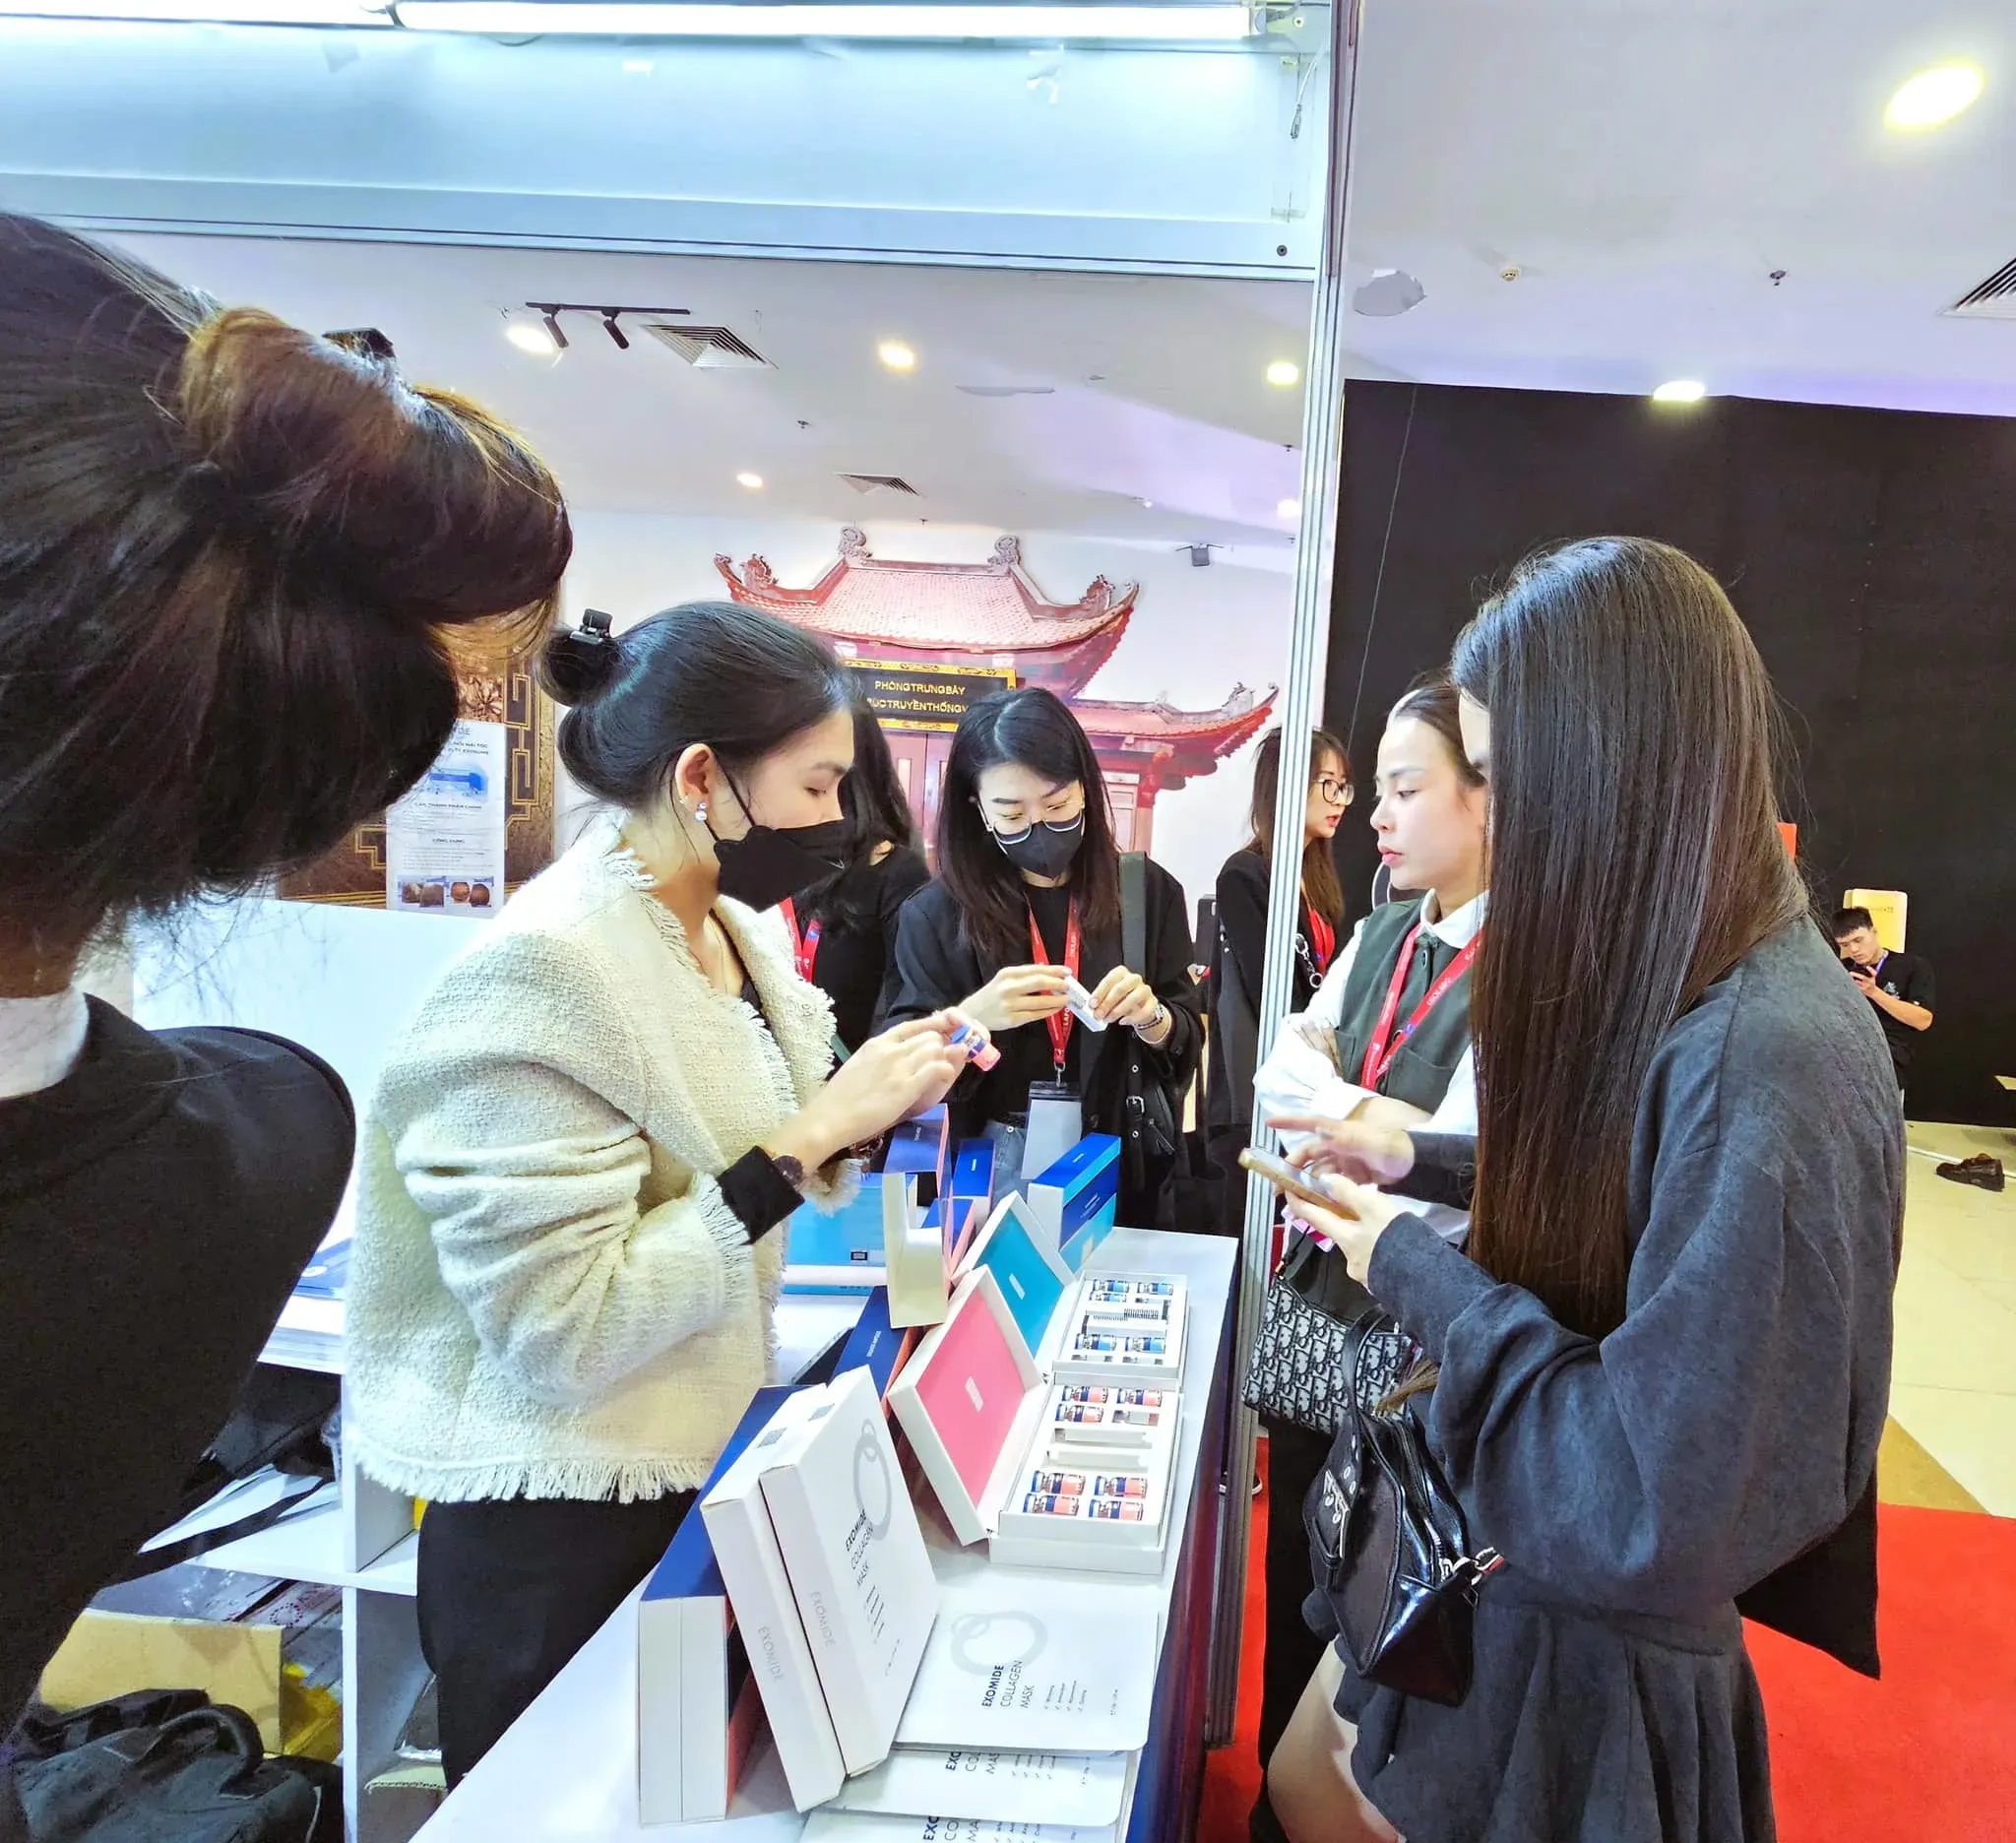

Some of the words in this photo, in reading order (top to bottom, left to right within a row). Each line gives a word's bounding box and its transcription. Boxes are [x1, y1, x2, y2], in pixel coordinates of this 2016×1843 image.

[810, 1591, 836, 1648] EXOMIDE
[757, 1625, 785, 1681] EXOMIDE
[981, 1665, 1004, 1708] EXOMIDE
[999, 1660, 1023, 1708] COLLAGEN
[1020, 1684, 1035, 1708] MASK
